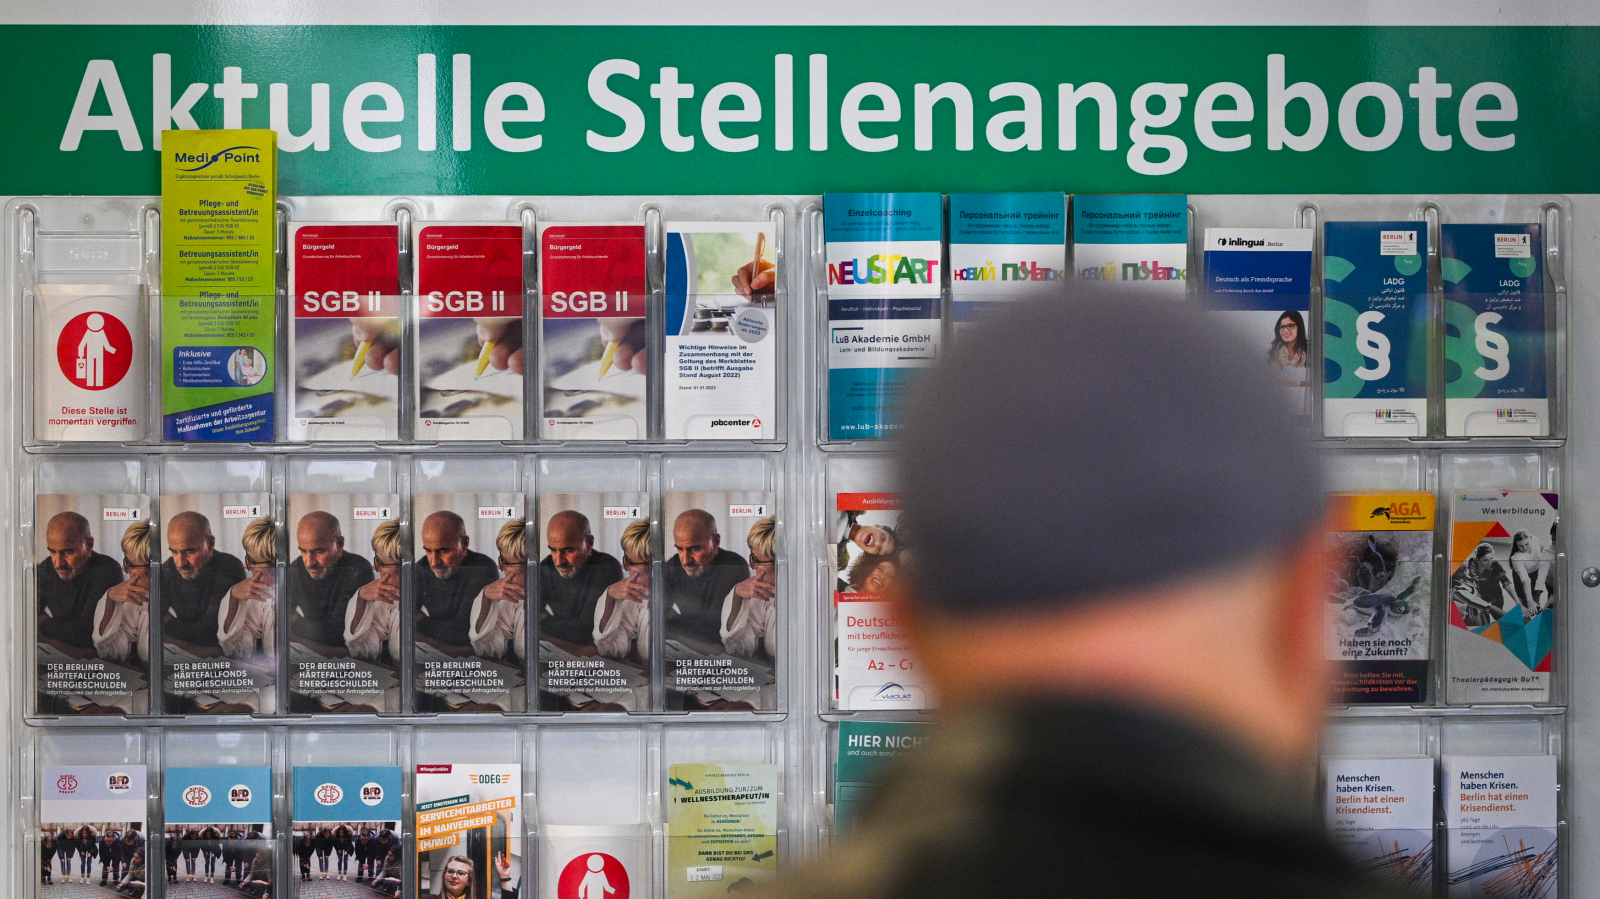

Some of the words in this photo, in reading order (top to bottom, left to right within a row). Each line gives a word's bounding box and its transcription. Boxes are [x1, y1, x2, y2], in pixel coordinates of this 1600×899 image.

[59, 53, 545, 152] Aktuelle
[586, 53, 1519, 175] Stellenangebote
[175, 152, 209, 162] Medi
[224, 152, 260, 162] Point
[179, 209, 259, 217] Betreuungsassistent/in
[848, 209, 911, 217] Einzelcoaching
[960, 211, 1020, 220] Персональний
[1024, 211, 1060, 220] трейнінг
[1082, 211, 1140, 220] Персональний
[1144, 211, 1181, 220] трейнінг
[1229, 238, 1264, 248] inlingua
[829, 254, 938, 285] NEUSTART
[180, 300, 259, 308] Betreuungsassistent/in
[303, 291, 360, 312] SGB
[368, 291, 380, 311] II
[427, 291, 484, 312] SGB
[492, 291, 504, 311] II
[550, 291, 607, 312] SGB
[615, 291, 628, 311] II
[902, 334, 930, 342] GmbH
[62, 407, 86, 415] Diese
[89, 407, 114, 415] Stelle
[116, 407, 127, 415] ist
[175, 413, 210, 425] Zertifizierte
[223, 404, 252, 415] geförderte
[177, 422, 212, 433] Maßnahmen
[711, 419, 750, 427] jobcenter
[1389, 502, 1421, 516] AGA
[1388, 638, 1411, 646] noch
[1364, 648, 1408, 656] Zukunft?
[192, 662, 231, 670] BERLINER
[868, 659, 884, 670] A2
[900, 659, 913, 670] C1
[47, 671, 120, 680] HÄRTEFALLFONDS
[174, 670, 247, 680] HÄRTEFALLFONDS
[300, 670, 372, 678] HÄRTEFALLFONDS
[676, 667, 748, 675] HÄRTEFALLFONDS
[175, 679, 253, 688] ENERGIESCHULDEN
[848, 735, 881, 747] HIER
[479, 774, 500, 784] ODEG
[1336, 774, 1380, 782] Menschen
[1460, 771, 1504, 779] Menschen
[110, 776, 129, 784] BFD
[231, 789, 249, 797] BFD
[363, 787, 381, 795] BFD
[681, 792, 769, 803] WELLNESSTHERAPEUT/IN
[420, 799, 512, 823] SERVICEMITARBEITER
[420, 827, 431, 836] IM
[434, 816, 493, 833] NAHVERKEHR
[420, 835, 456, 851] (M/W/D)
